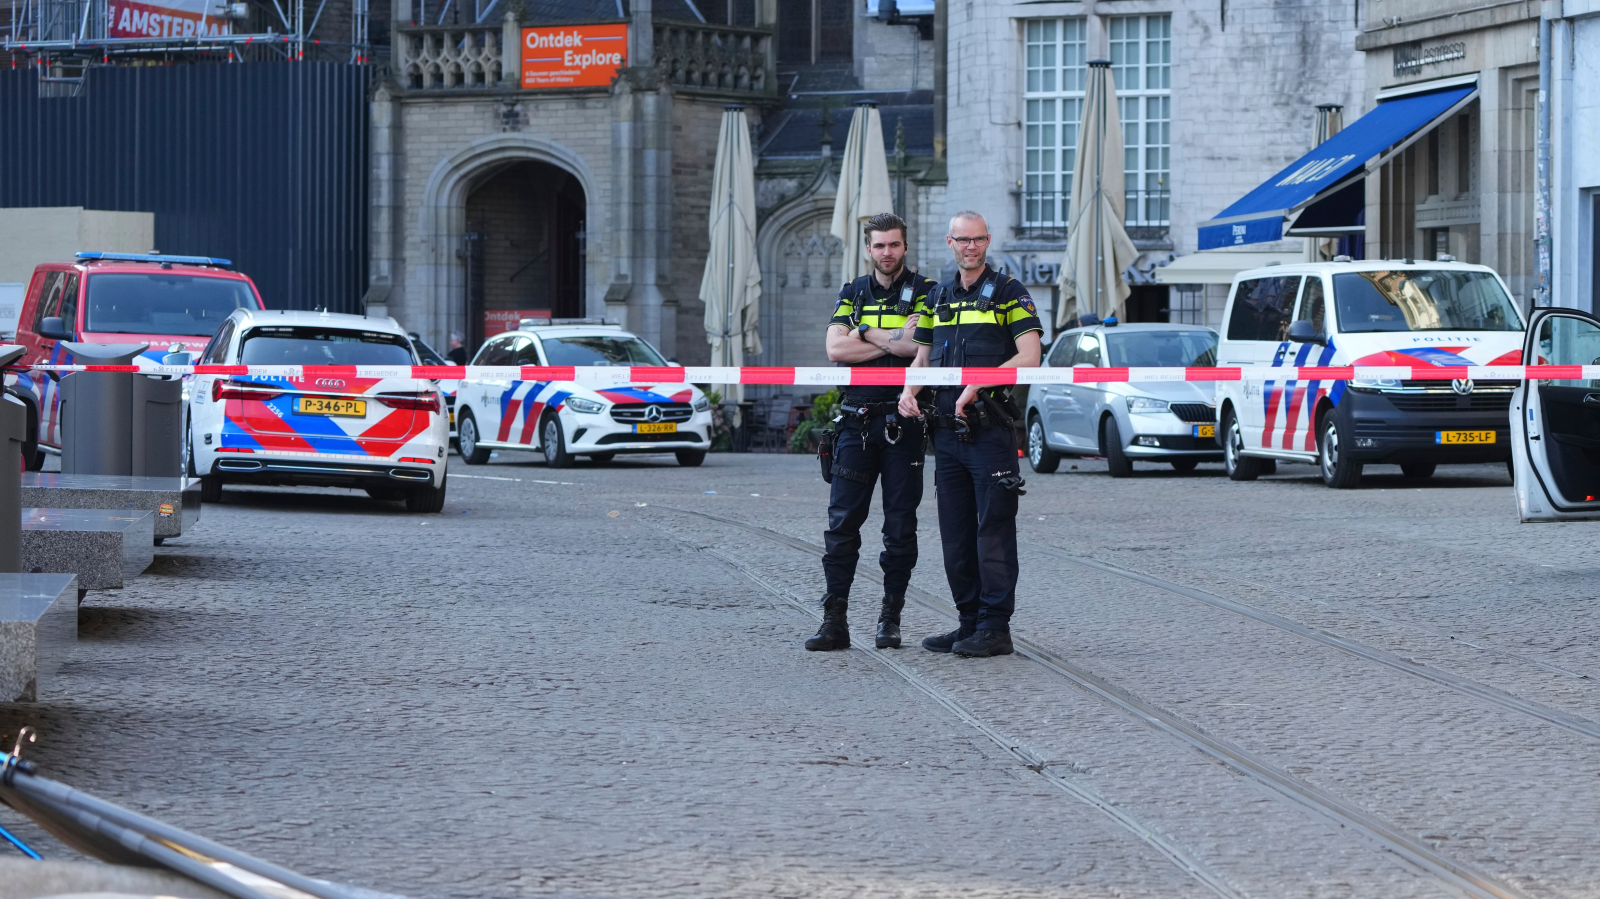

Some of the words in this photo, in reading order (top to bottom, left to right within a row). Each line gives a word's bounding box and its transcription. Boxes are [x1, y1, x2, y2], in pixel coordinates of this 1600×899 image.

[117, 7, 228, 38] AMSTERDA
[526, 30, 582, 49] Ontdek
[564, 48, 621, 69] Explore
[251, 375, 306, 383] POLITIE
[266, 402, 284, 418] 2256
[305, 399, 361, 413] P-346-PL
[639, 424, 674, 432] L-326-RR
[1446, 432, 1492, 442] L-735-LF
